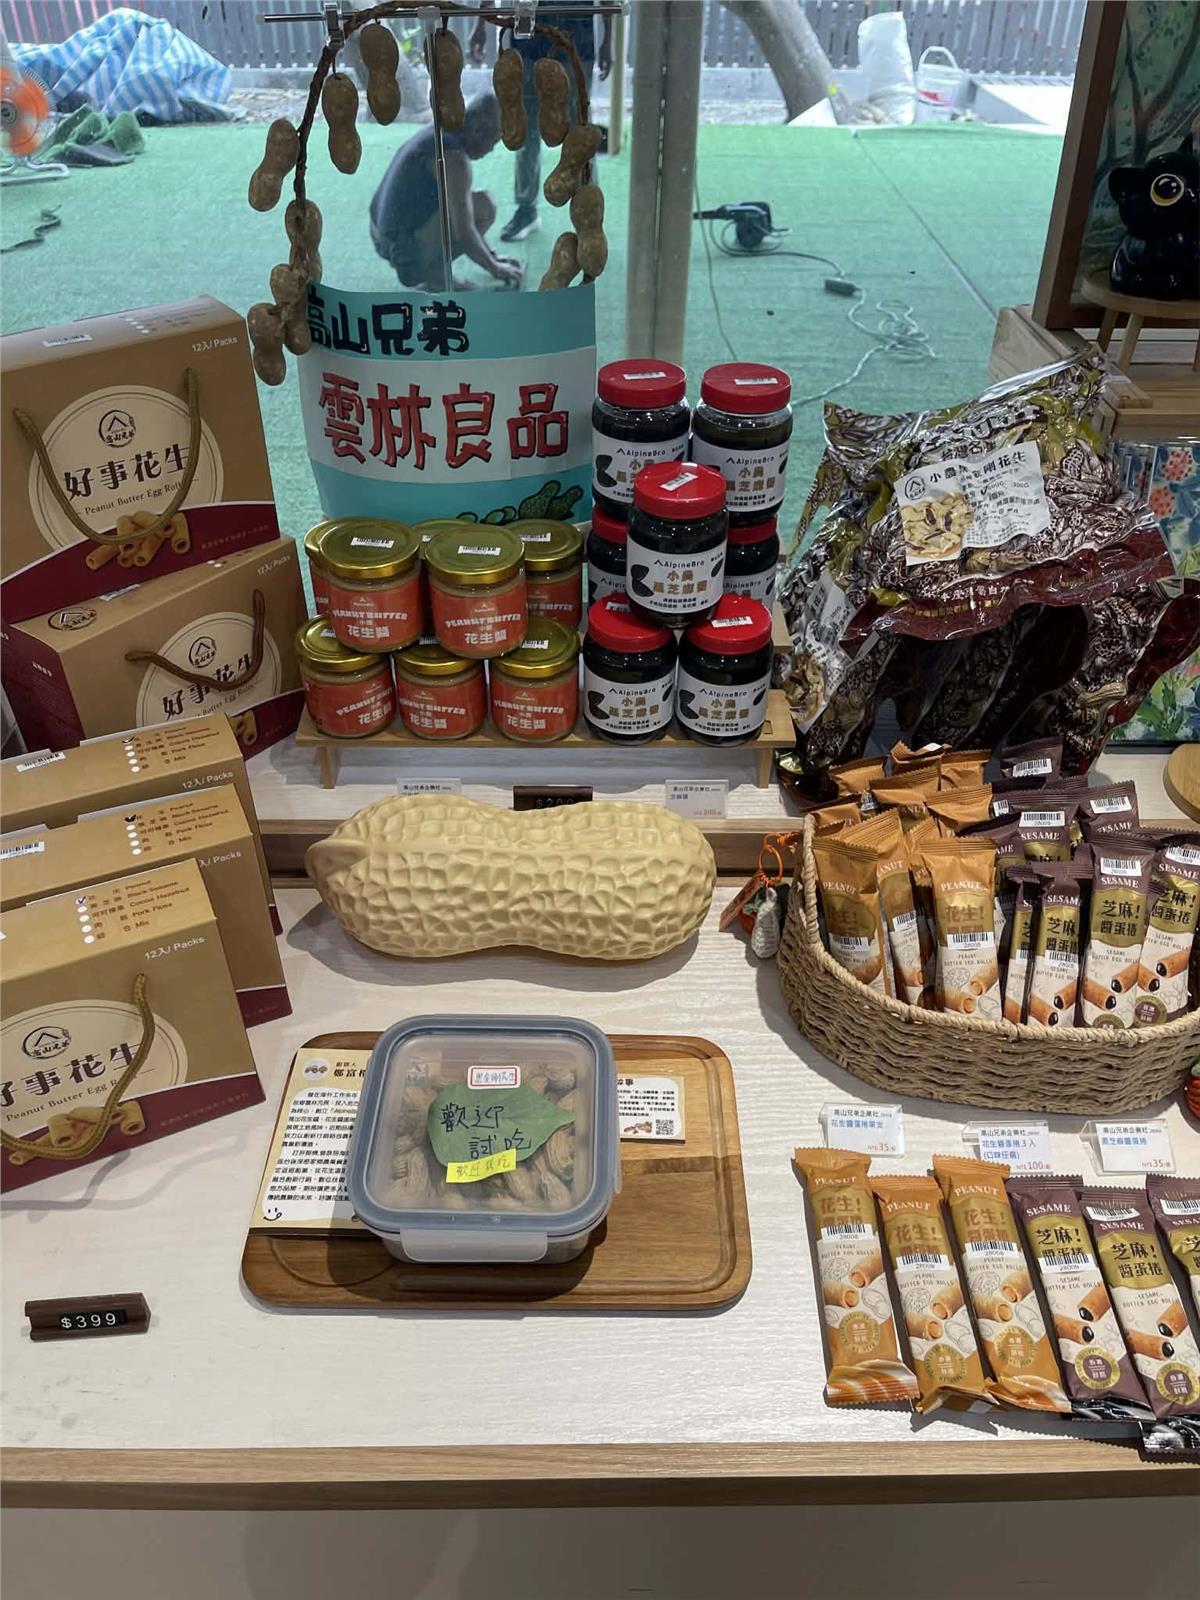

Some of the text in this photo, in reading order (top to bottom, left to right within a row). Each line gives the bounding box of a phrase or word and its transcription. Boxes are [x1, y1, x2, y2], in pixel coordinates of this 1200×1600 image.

[319, 372, 570, 471] 雲林良品
[63, 443, 192, 502] 好事花生
[85, 481, 182, 516] Peanut Butter Egg Roll
[664, 559, 705, 570] AlpineBro
[367, 610, 408, 621] BUTTER
[347, 624, 391, 639] 花生醬
[464, 630, 507, 645] 花生醬
[618, 687, 656, 696] AlpineBro
[707, 688, 748, 698] AlpineBro
[410, 713, 448, 729] 花生醬
[506, 715, 546, 729] 花生醬
[206, 770, 234, 783] Packs
[1020, 832, 1060, 844] SESAME
[212, 851, 242, 864] Packs
[1158, 862, 1200, 879] SESAME
[821, 881, 857, 895] PEANUT
[940, 881, 982, 892] PEANUT
[1101, 876, 1139, 889] SESAME
[1101, 899, 1141, 920] 芝麻!
[173, 936, 206, 952] Packs
[6, 1103, 45, 1122] Peanut
[48, 1091, 85, 1108] Butter
[87, 1083, 108, 1098] Egg
[440, 1101, 505, 1133] 歡迎
[814, 1174, 857, 1186] PEANUT
[954, 1184, 999, 1197] PEANUT
[820, 1195, 861, 1215] 花生!
[887, 1199, 930, 1213] PEANUT
[1026, 1203, 1072, 1217] SESAME
[964, 1208, 1005, 1227] 花生!
[895, 1223, 937, 1242] 花生!
[1099, 1221, 1145, 1231] SESAME
[1034, 1226, 1082, 1245] 芝麻!
[1111, 1242, 1158, 1261] 芝麻!
[1118, 1262, 1164, 1279] 醬蛋捲
[60, 1312, 117, 1329] $399
